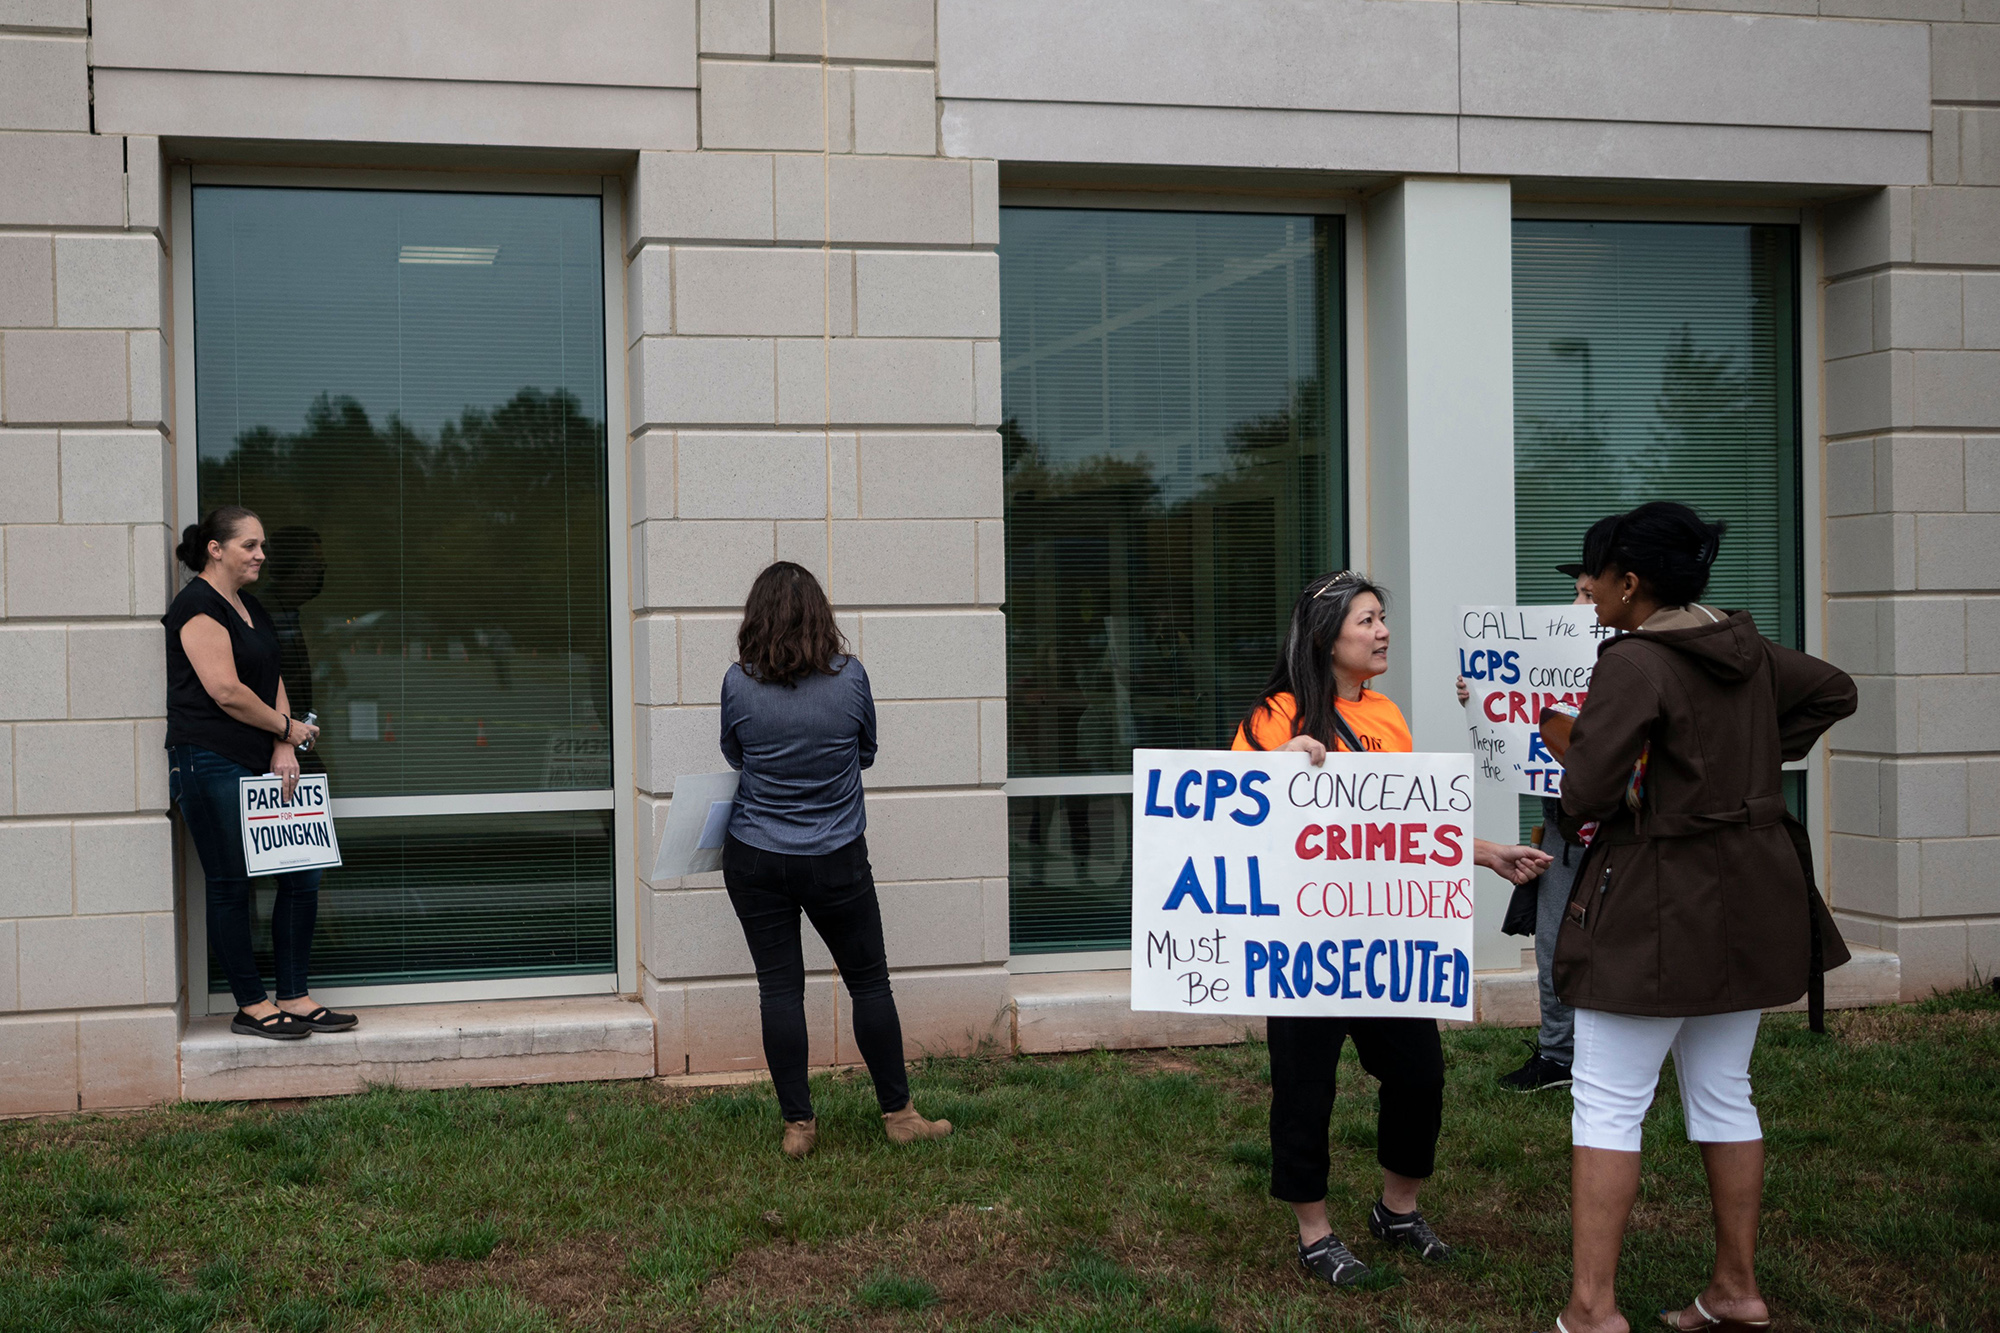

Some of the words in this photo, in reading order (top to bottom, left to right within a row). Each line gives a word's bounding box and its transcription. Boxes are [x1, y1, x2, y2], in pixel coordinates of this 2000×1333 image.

[1463, 611, 1537, 641] CALL
[1546, 615, 1579, 637] the
[1459, 648, 1521, 685] LCPS
[1481, 757, 1506, 782] the
[1144, 768, 1272, 827] LCPS
[1288, 771, 1472, 812] CONCEALS
[280, 812, 293, 821] FOR
[249, 821, 331, 855] YOUNGKIN
[1294, 822, 1464, 867] CRIMES
[1161, 855, 1280, 917] ALL
[1296, 878, 1473, 919] COLLUDERS
[1177, 971, 1230, 1006] Be
[1244, 938, 1469, 1008] PROSECUTED
